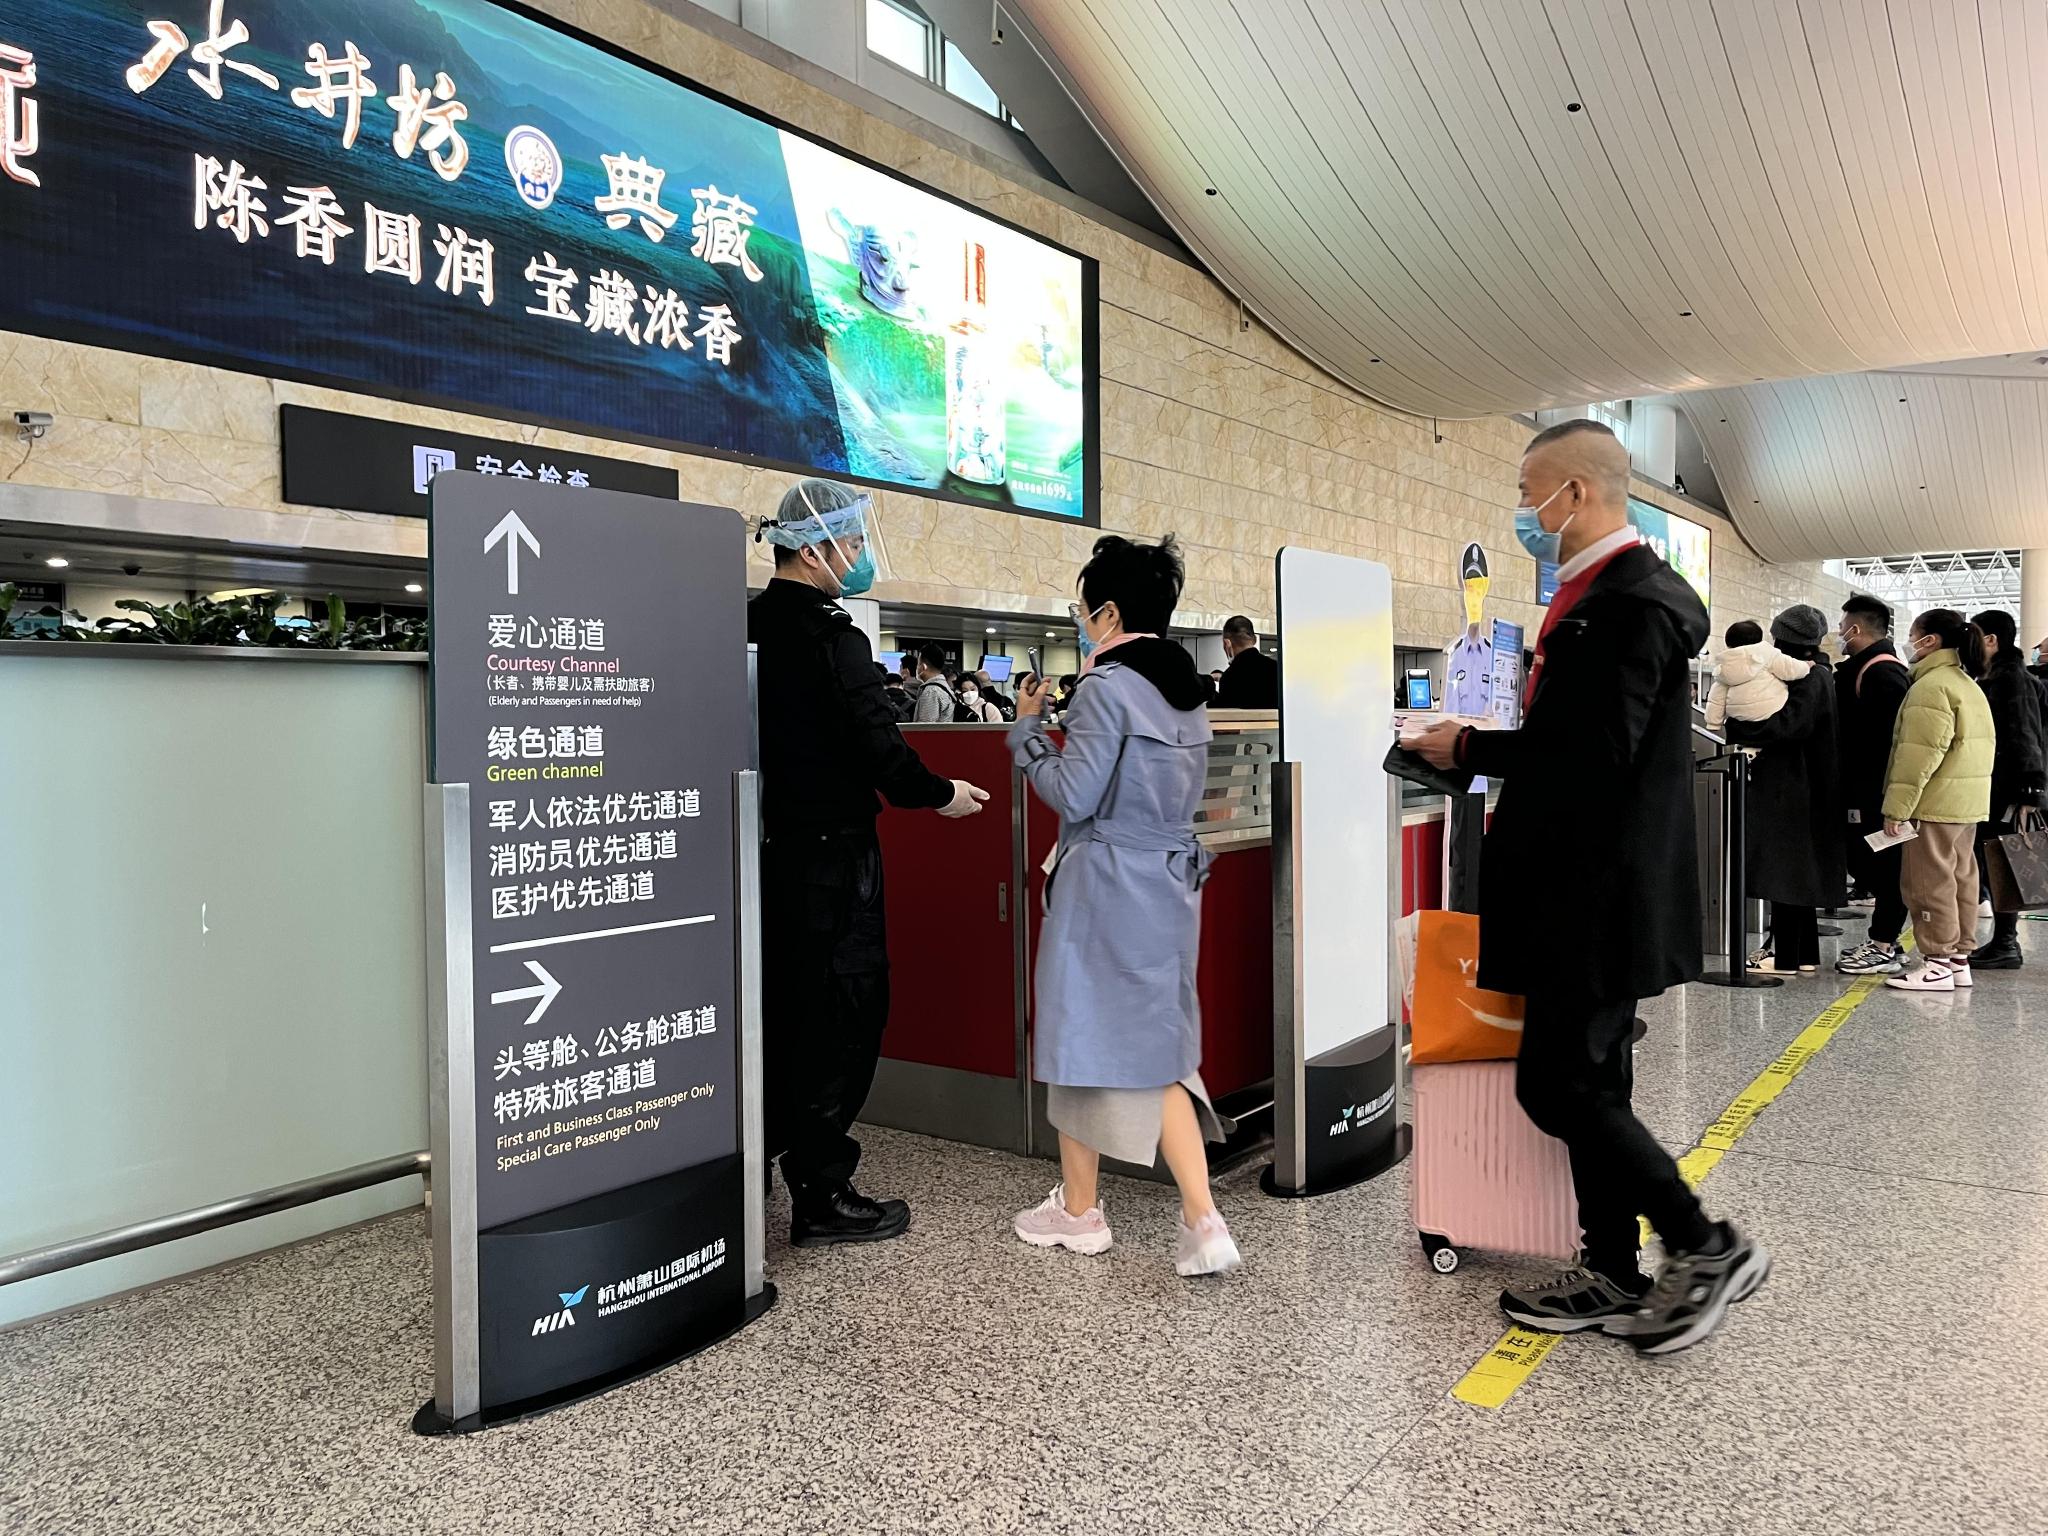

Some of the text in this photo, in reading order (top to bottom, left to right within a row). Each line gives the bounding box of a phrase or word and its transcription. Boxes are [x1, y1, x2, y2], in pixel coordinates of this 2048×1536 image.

[126, 0, 468, 182] 水井坊
[194, 153, 495, 306] 陈香圆润
[594, 151, 764, 282] 典藏
[525, 252, 742, 366] 宝藏浓香
[487, 614, 605, 652] 爱心通道
[486, 654, 620, 675] Courtesy Channel
[488, 695, 641, 709] (Elderly and Passengers in need of help)
[486, 760, 604, 783] Green channel
[487, 725, 605, 761] 绿色通道
[488, 788, 702, 834] 军人依法优先通道
[488, 829, 679, 877] 消防员优先通道
[491, 870, 655, 920] 医护优先通道
[493, 1004, 718, 1082] 头等舱、公务舱通道
[493, 1057, 657, 1124] 特殊旅客通道
[496, 1082, 715, 1150] First and Business Class Passenger Only
[497, 1115, 661, 1172] Special Care Passenger Only
[531, 1254, 726, 1337] HIA HANGZHOU INTERNATIONAL AIRPORT
[597, 1237, 726, 1305] 杭州萧山国际机场
